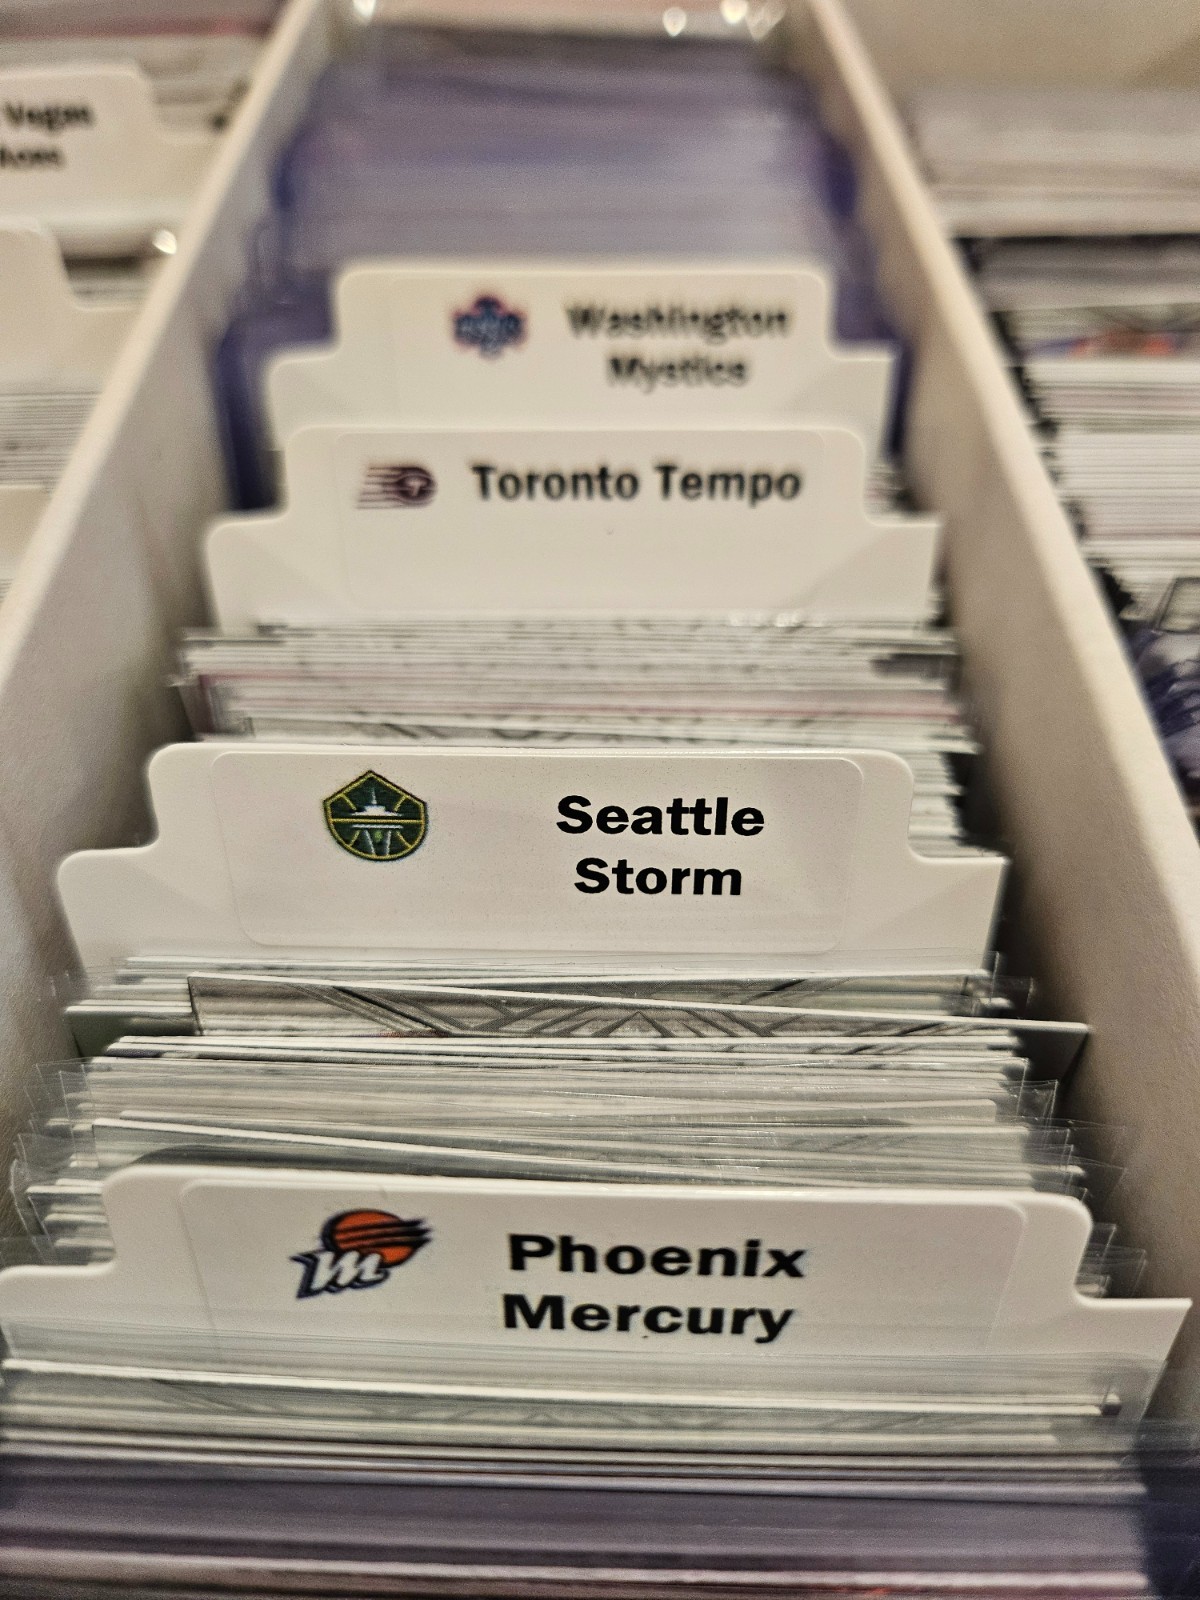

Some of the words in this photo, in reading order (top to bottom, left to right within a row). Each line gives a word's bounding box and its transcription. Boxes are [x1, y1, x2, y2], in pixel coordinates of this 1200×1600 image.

[565, 304, 790, 342] Washington
[607, 355, 748, 391] Mystics
[469, 462, 641, 501] Toronto
[653, 460, 804, 508] Tempo
[555, 794, 766, 838] Seattle
[573, 856, 743, 897] Storm
[507, 1232, 808, 1280] Phoenix
[501, 1292, 796, 1345] Mercury
